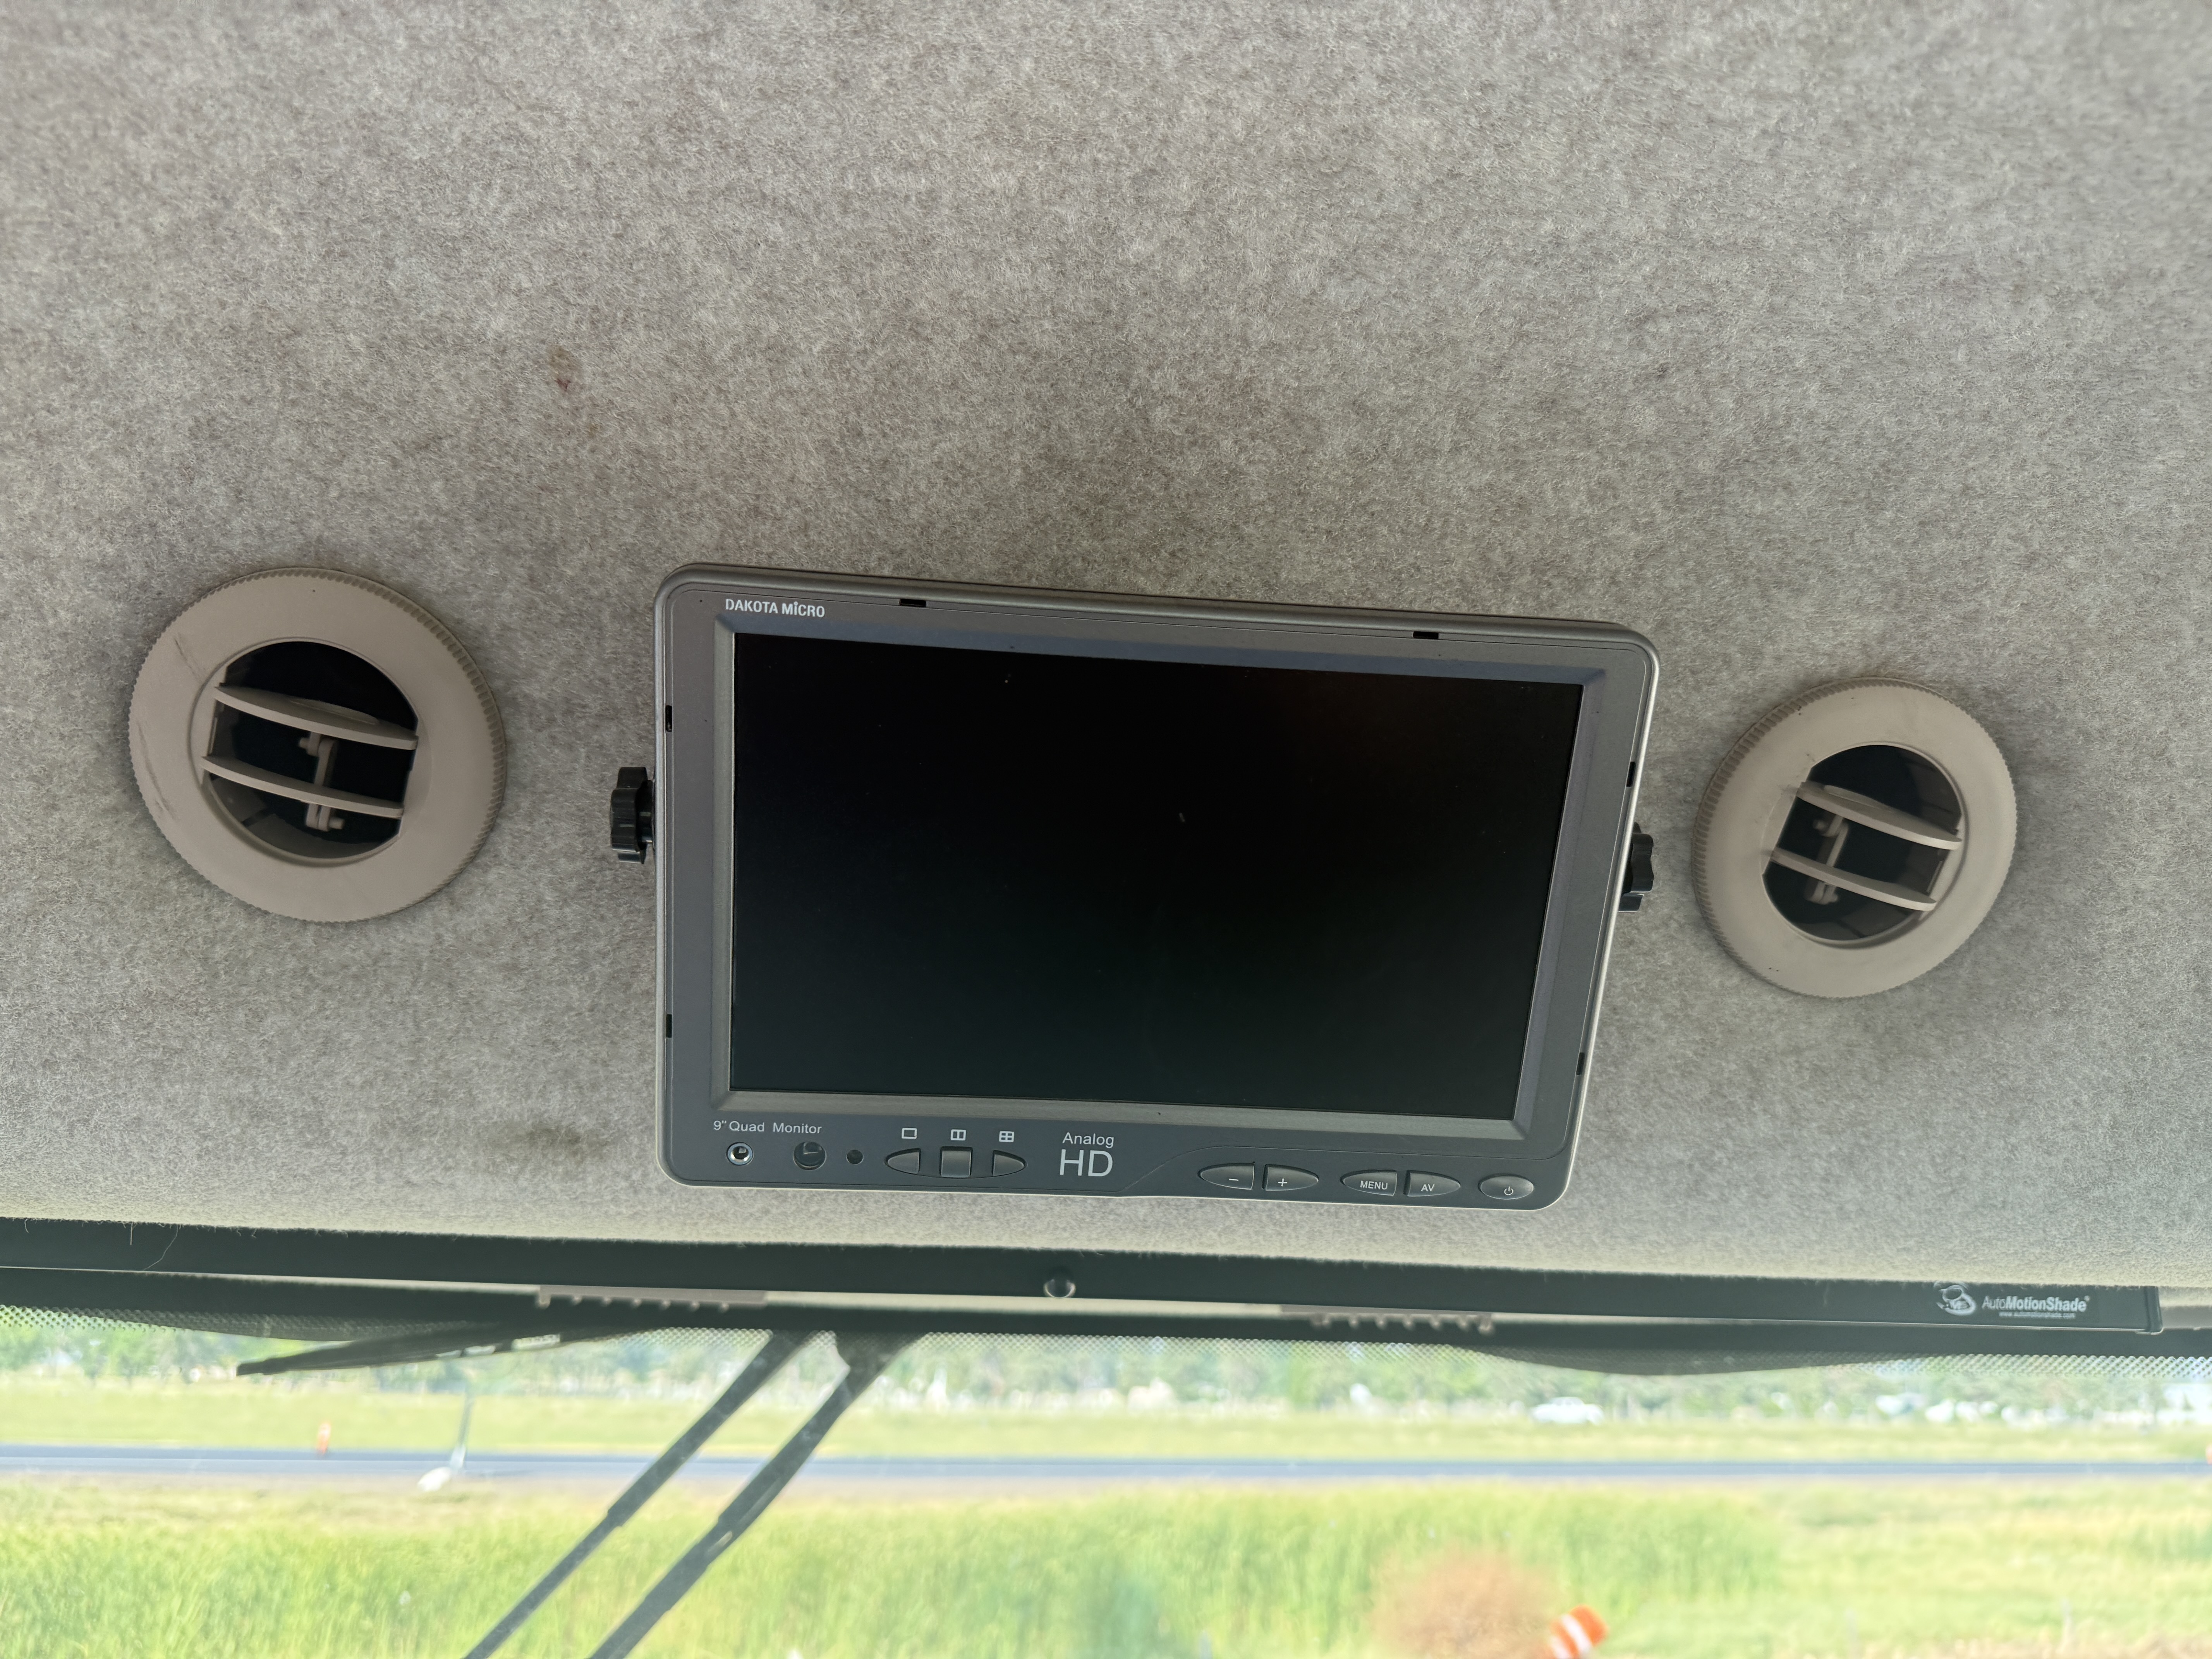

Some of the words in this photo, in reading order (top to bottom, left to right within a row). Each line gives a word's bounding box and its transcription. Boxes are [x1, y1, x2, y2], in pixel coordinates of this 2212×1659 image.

[725, 599, 778, 614] DAKOTA
[729, 1120, 765, 1132] Quad
[773, 1122, 822, 1134] Monitor
[1062, 1132, 1114, 1149] Analog
[1060, 1149, 1113, 1177] HD
[1360, 1180, 1388, 1190] MENU
[1420, 1183, 1435, 1192] AV
